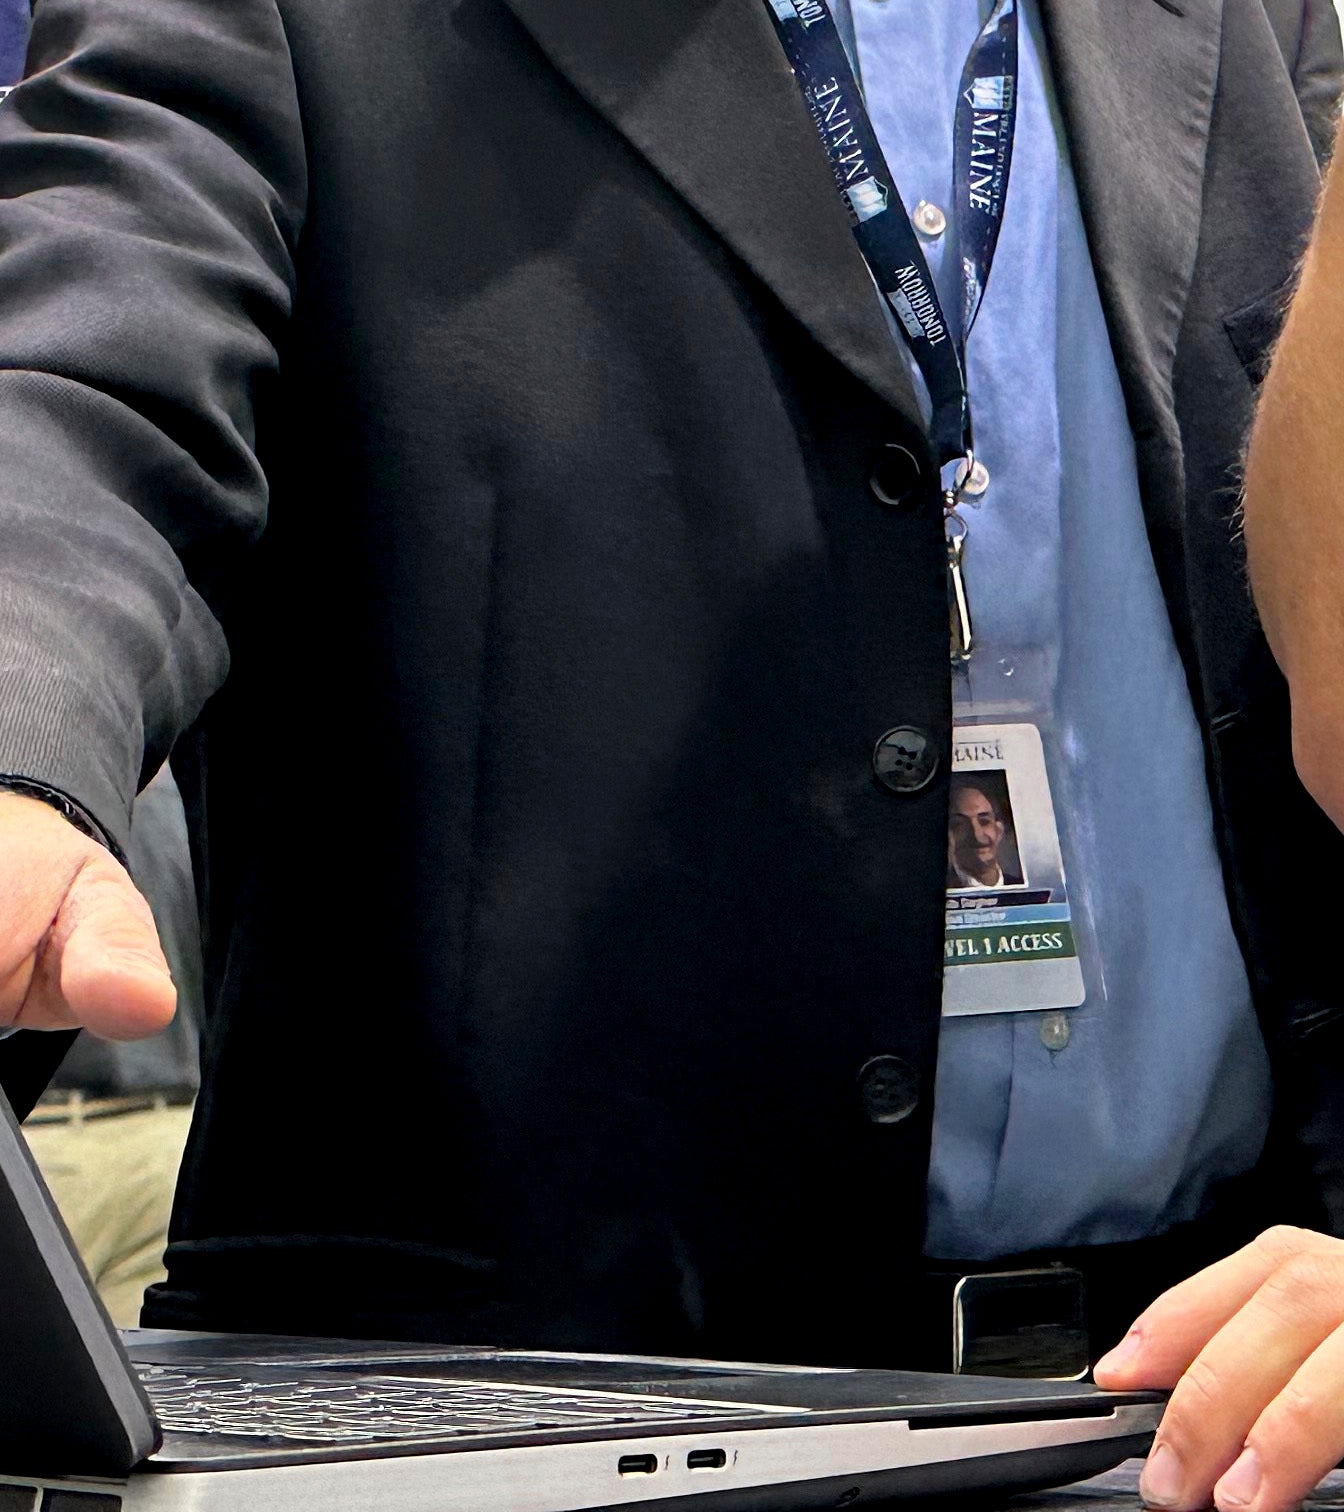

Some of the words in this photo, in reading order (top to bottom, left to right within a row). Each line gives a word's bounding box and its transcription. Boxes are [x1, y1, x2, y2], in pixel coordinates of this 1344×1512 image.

[814, 76, 869, 181] MAINE
[969, 112, 999, 215] MAINE
[894, 263, 947, 347] TOMORROW
[997, 932, 1063, 954] ACCESS
